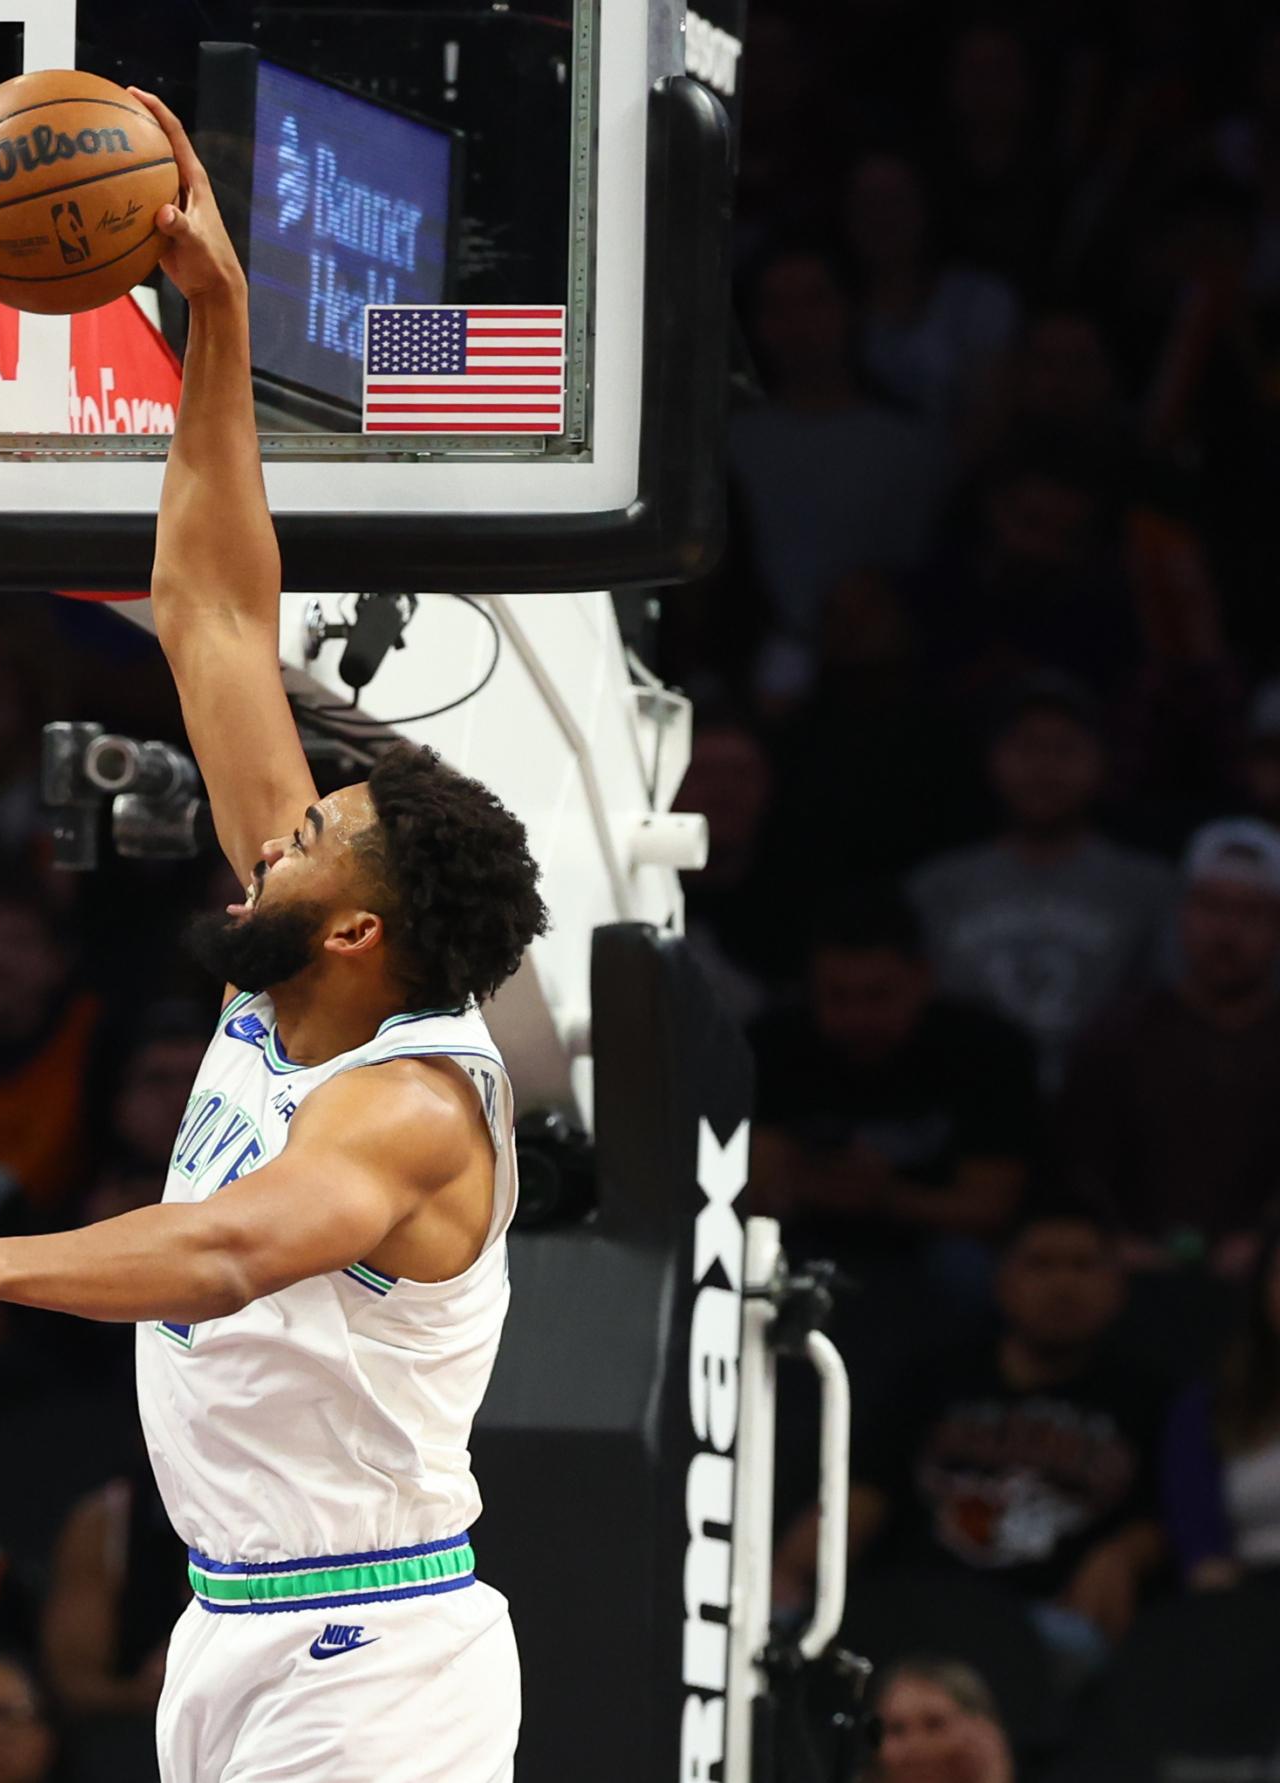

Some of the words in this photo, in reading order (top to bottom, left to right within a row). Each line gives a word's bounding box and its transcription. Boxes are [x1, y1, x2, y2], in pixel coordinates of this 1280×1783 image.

[314, 146, 422, 271] Banner
[172, 1089, 266, 1195] OLVE
[320, 1624, 364, 1646] NIKE
